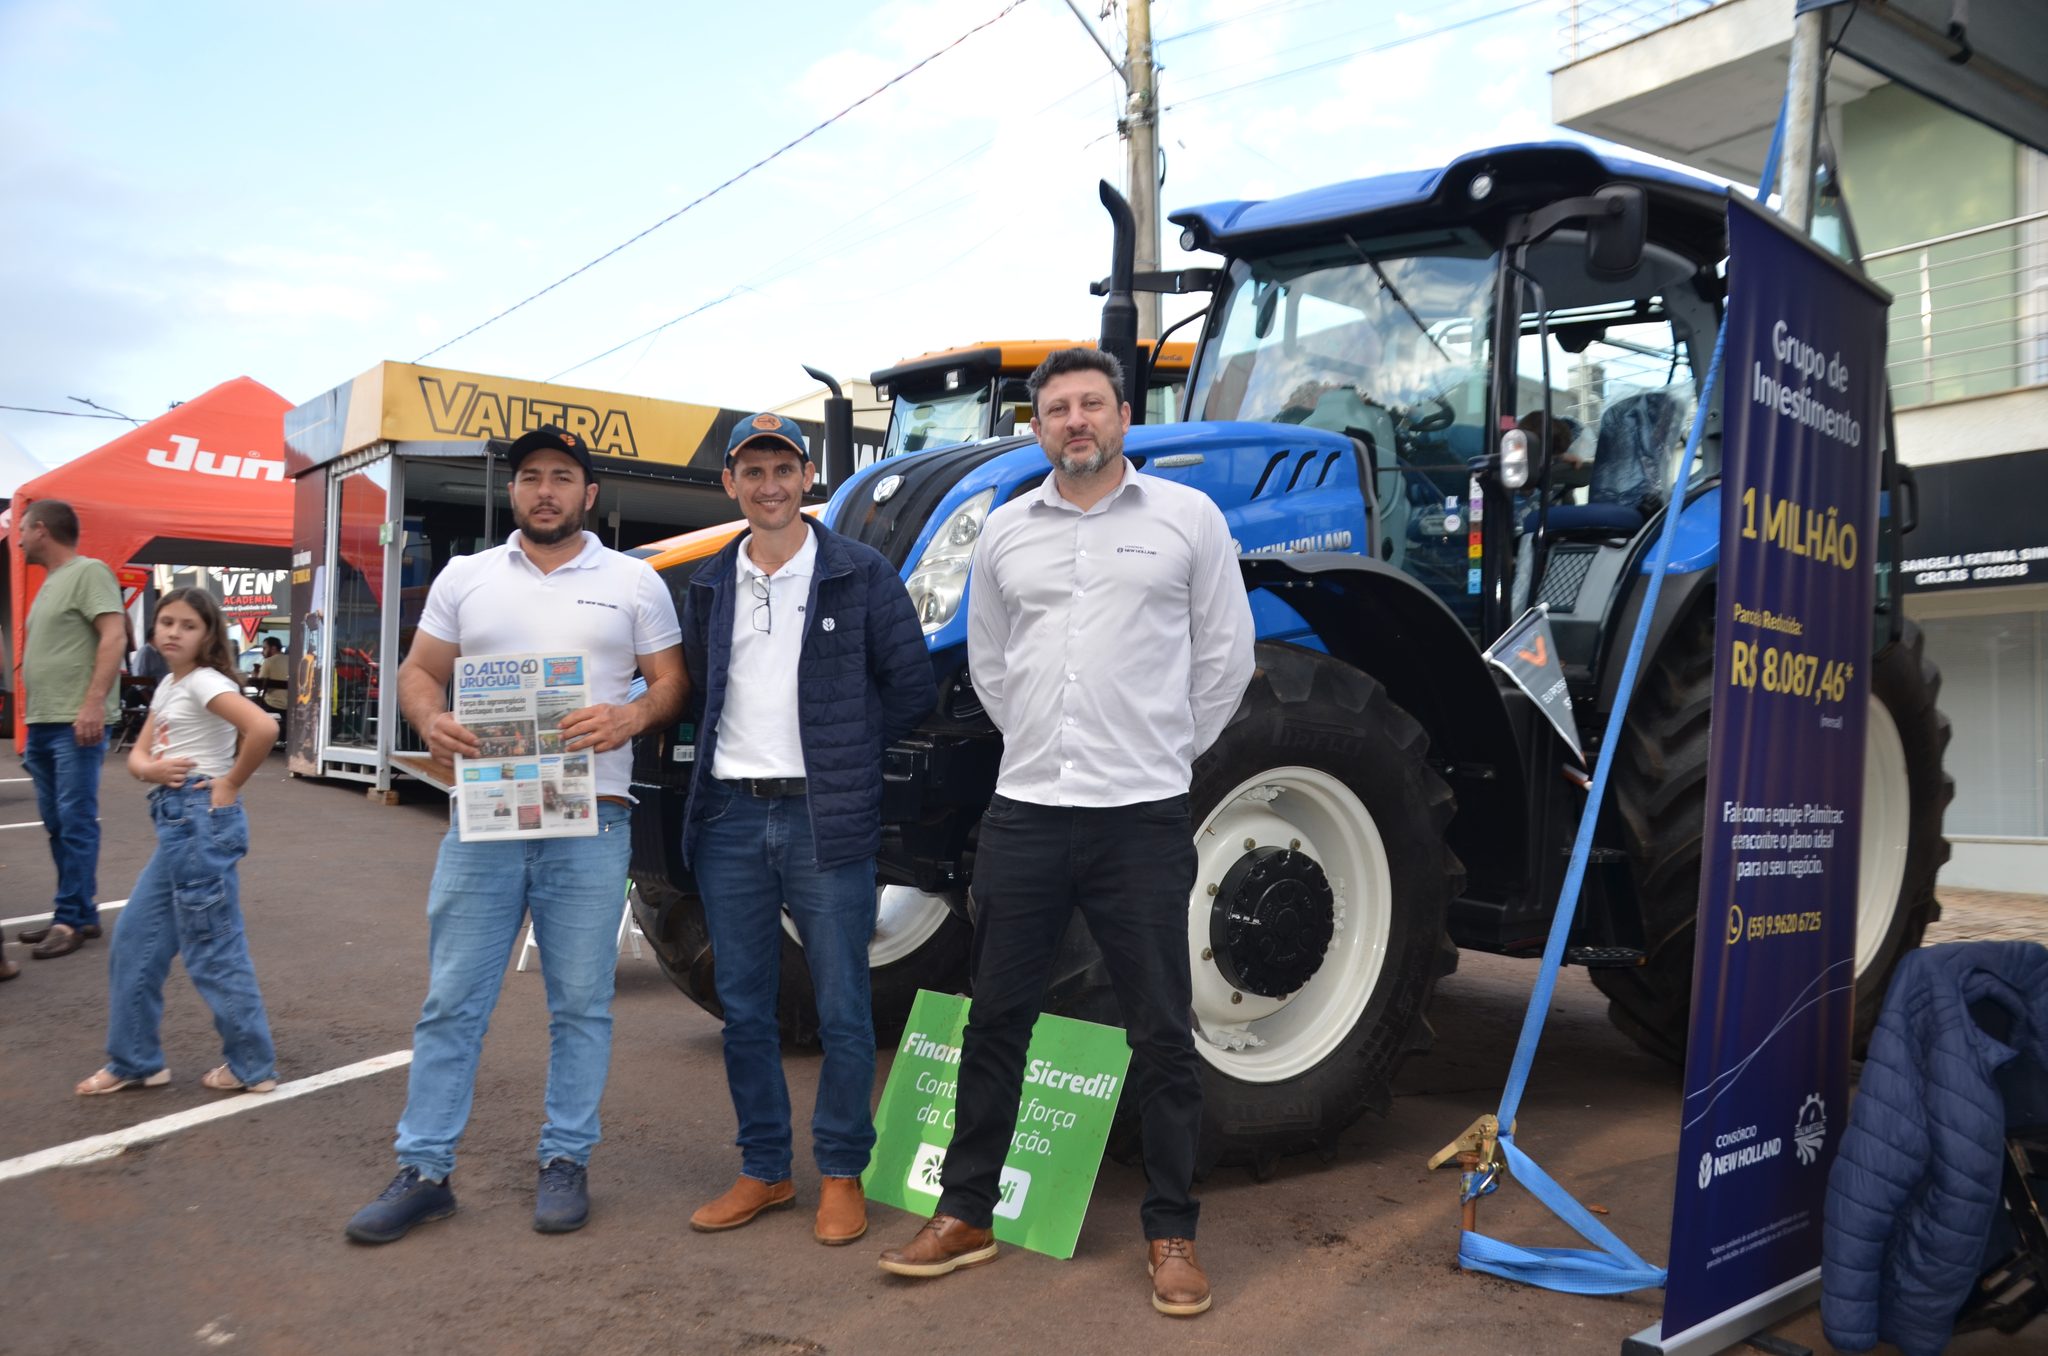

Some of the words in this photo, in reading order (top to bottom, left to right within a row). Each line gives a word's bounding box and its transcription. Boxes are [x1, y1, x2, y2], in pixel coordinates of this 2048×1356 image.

[1772, 320, 1825, 381] Grupo
[1828, 351, 1848, 393] de
[418, 376, 638, 457] VALTRA
[1753, 360, 1860, 447] Investimento
[1290, 530, 1351, 553] HOLLAND
[1742, 487, 1757, 539] 1
[1762, 493, 1857, 570] MILHÃO
[1900, 554, 1962, 573] SANGELA
[1962, 549, 2018, 567] FATIMA
[222, 572, 274, 596] VEN
[223, 595, 273, 605] ACADEMIA
[1733, 602, 1761, 627] Parcela
[1761, 610, 1804, 636] Reduzida:
[463, 663, 475, 676] O
[477, 661, 519, 675] ALTO
[521, 659, 538, 674] 60
[1731, 640, 1758, 693] R$
[459, 674, 520, 689] URUGUAI
[1723, 801, 1742, 822] Fale
[1742, 807, 1765, 822] com
[1766, 808, 1772, 822] a
[1772, 803, 1802, 827] equipe
[1738, 831, 1779, 850] encontre
[1780, 835, 1787, 849] o
[1788, 829, 1812, 853] plano
[1813, 829, 1835, 849] ideal
[1736, 861, 1761, 881] para
[1762, 861, 1769, 876] o
[1769, 861, 1786, 875] seu
[1787, 854, 1824, 878] negócio.
[1747, 915, 1765, 941] (55)
[1799, 911, 1821, 932] 6725
[903, 1032, 961, 1064] Finan
[1025, 1059, 1118, 1100] Sicredi!
[916, 1071, 957, 1099] Cont
[1020, 1098, 1076, 1131] força
[917, 1103, 940, 1125] da
[1716, 1125, 1757, 1148] CONSÓRCIO
[1714, 1151, 1738, 1176] NEW
[1738, 1138, 1781, 1168] HOLLAND
